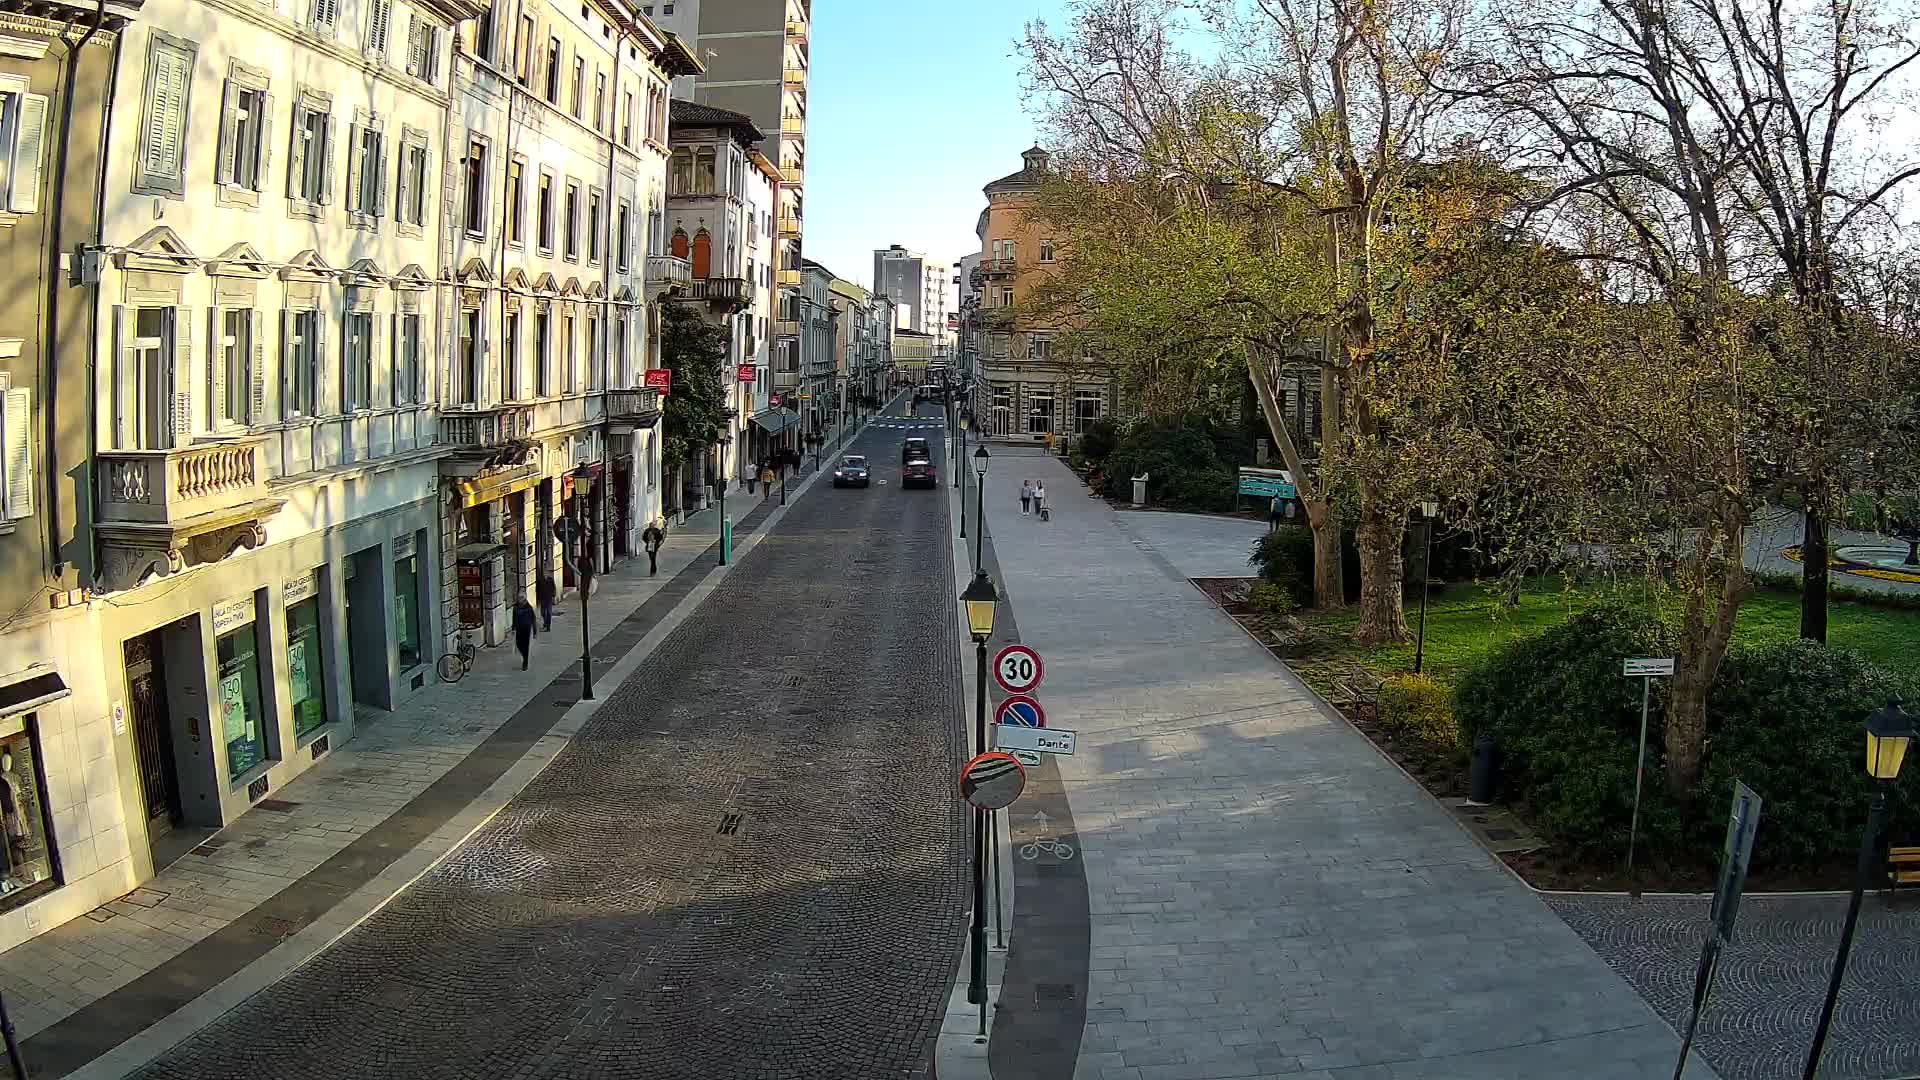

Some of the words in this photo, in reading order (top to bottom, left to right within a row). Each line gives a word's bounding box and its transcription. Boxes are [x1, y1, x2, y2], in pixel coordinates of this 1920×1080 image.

[1005, 658, 1032, 680] 30
[222, 678, 240, 700] 130
[1037, 737, 1069, 749] Dante
